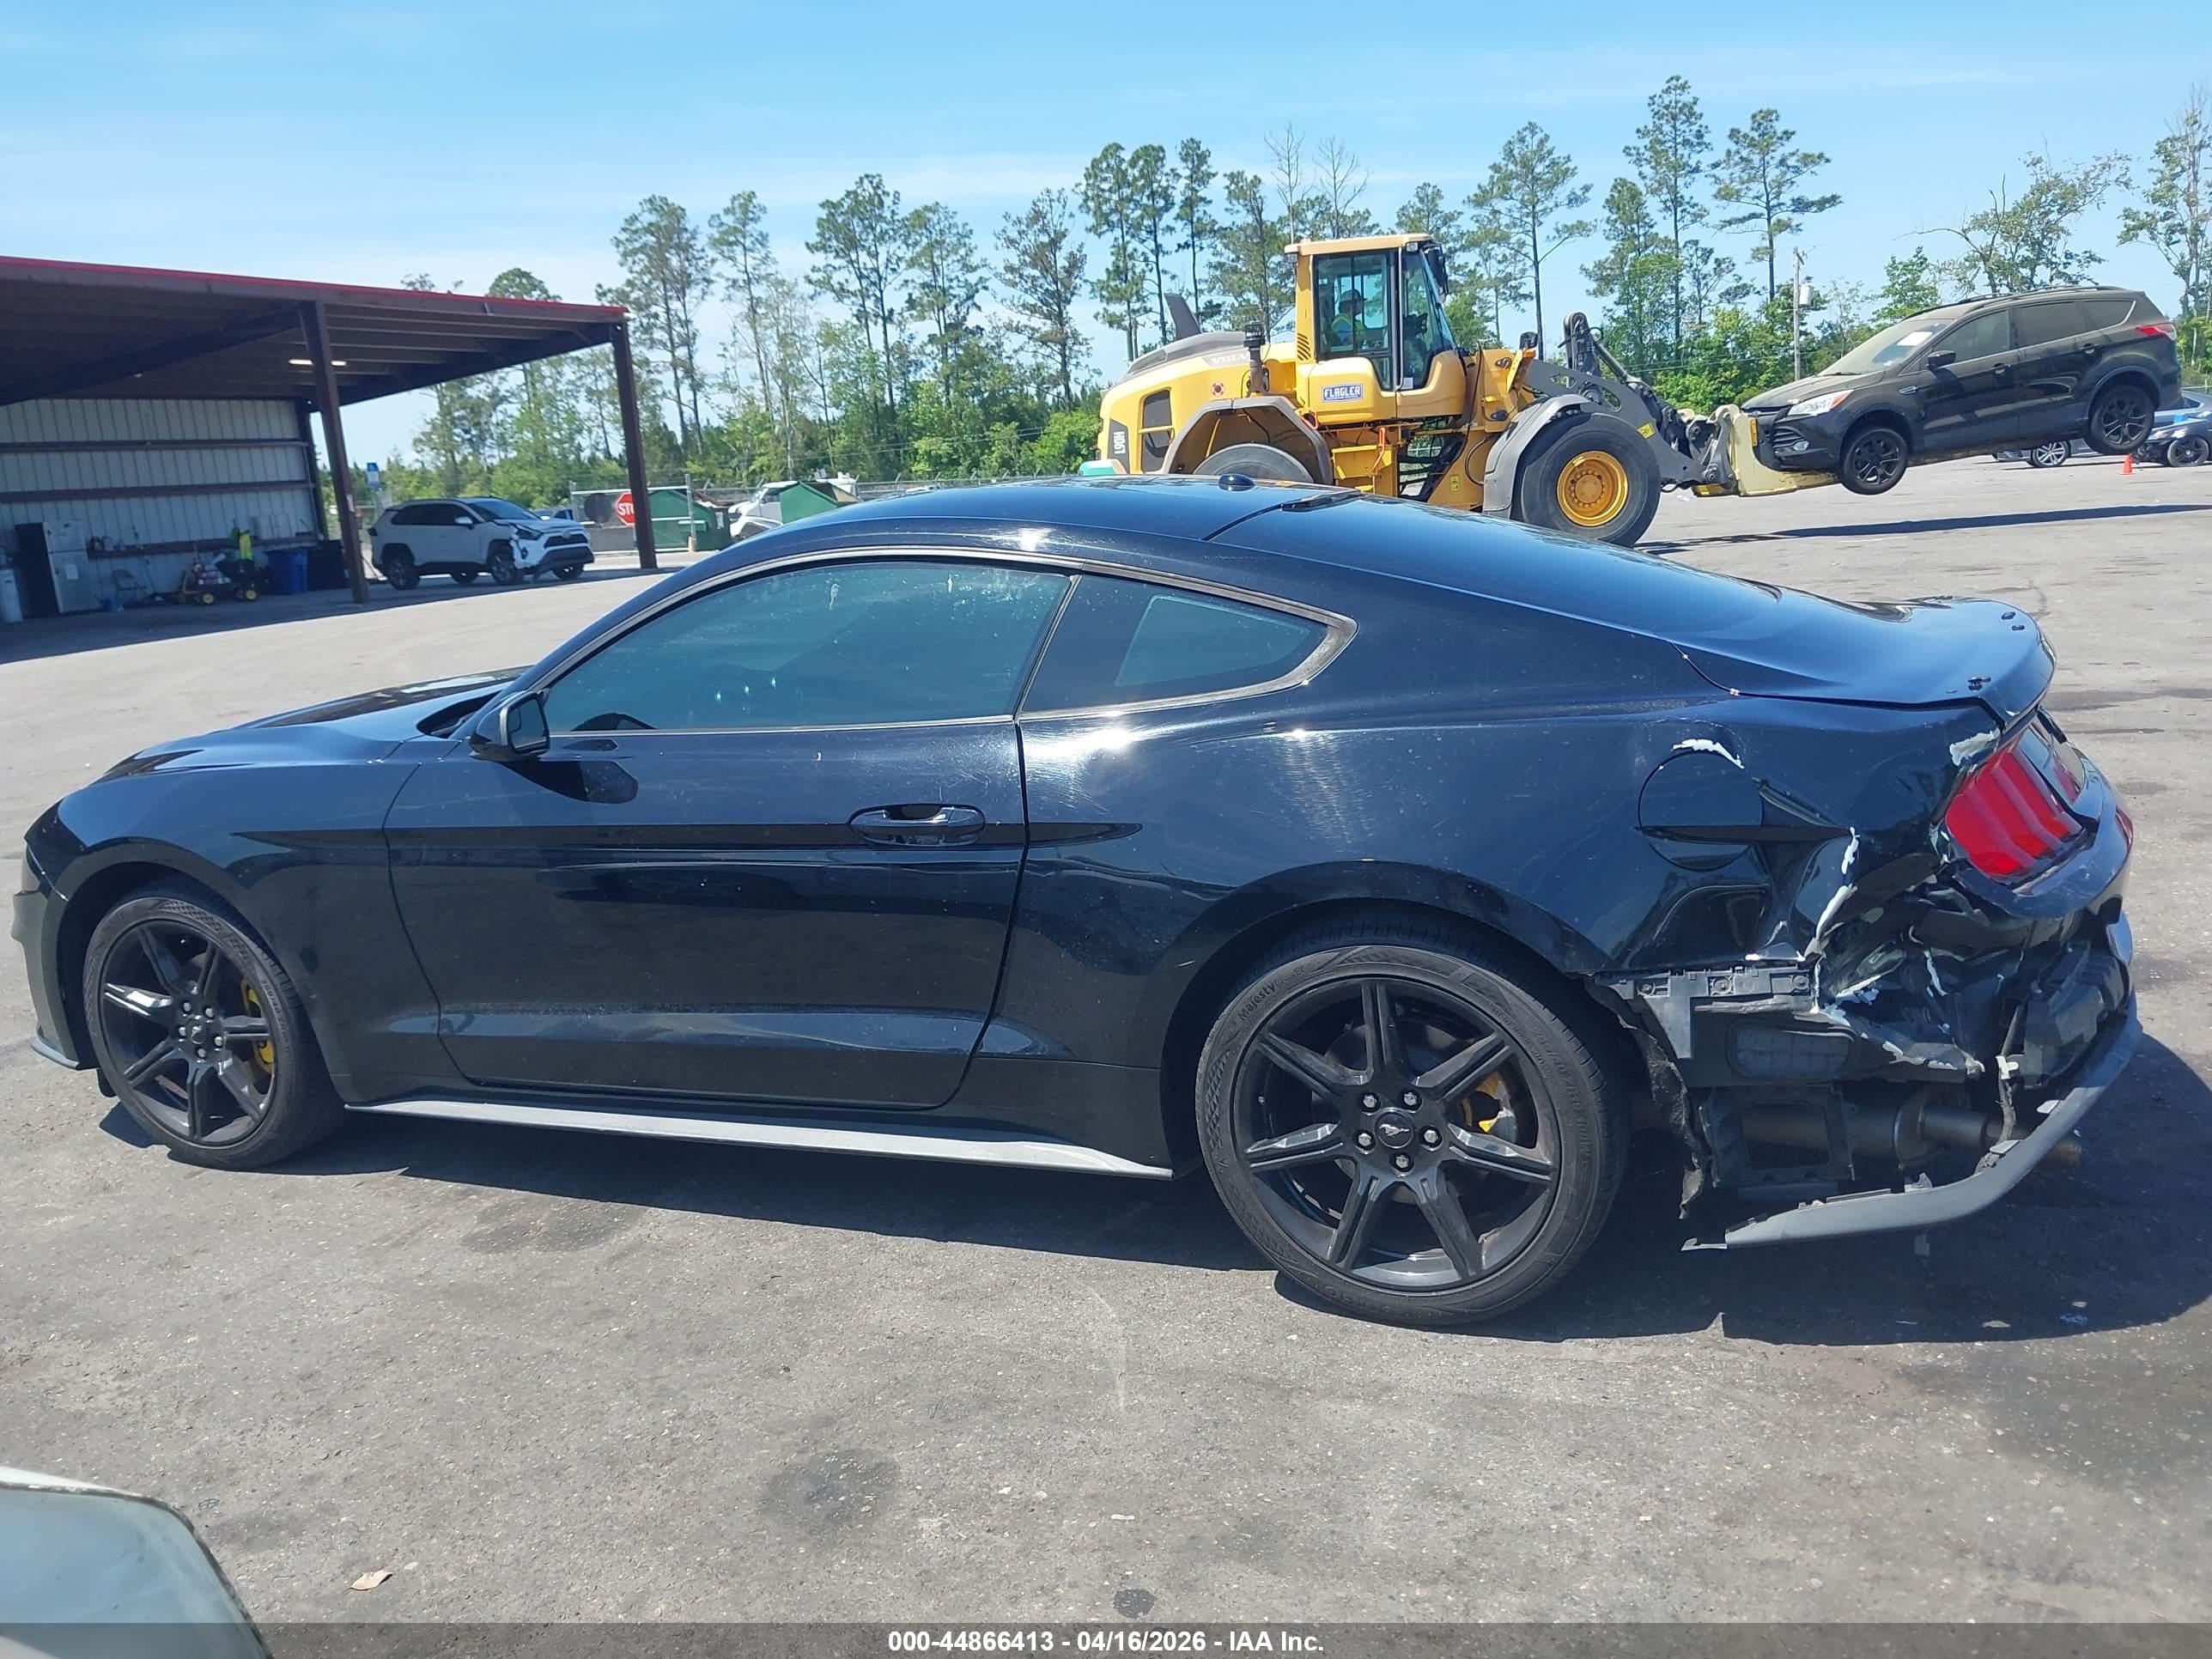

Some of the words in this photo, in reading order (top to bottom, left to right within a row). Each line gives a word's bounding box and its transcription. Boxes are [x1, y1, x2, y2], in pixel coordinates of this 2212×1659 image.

[1210, 352, 1250, 364] VOLV
[1324, 386, 1361, 398] FLAGLER
[1113, 431, 1127, 454] L90H
[617, 501, 635, 516] ST
[1237, 981, 1276, 1021] Majesty
